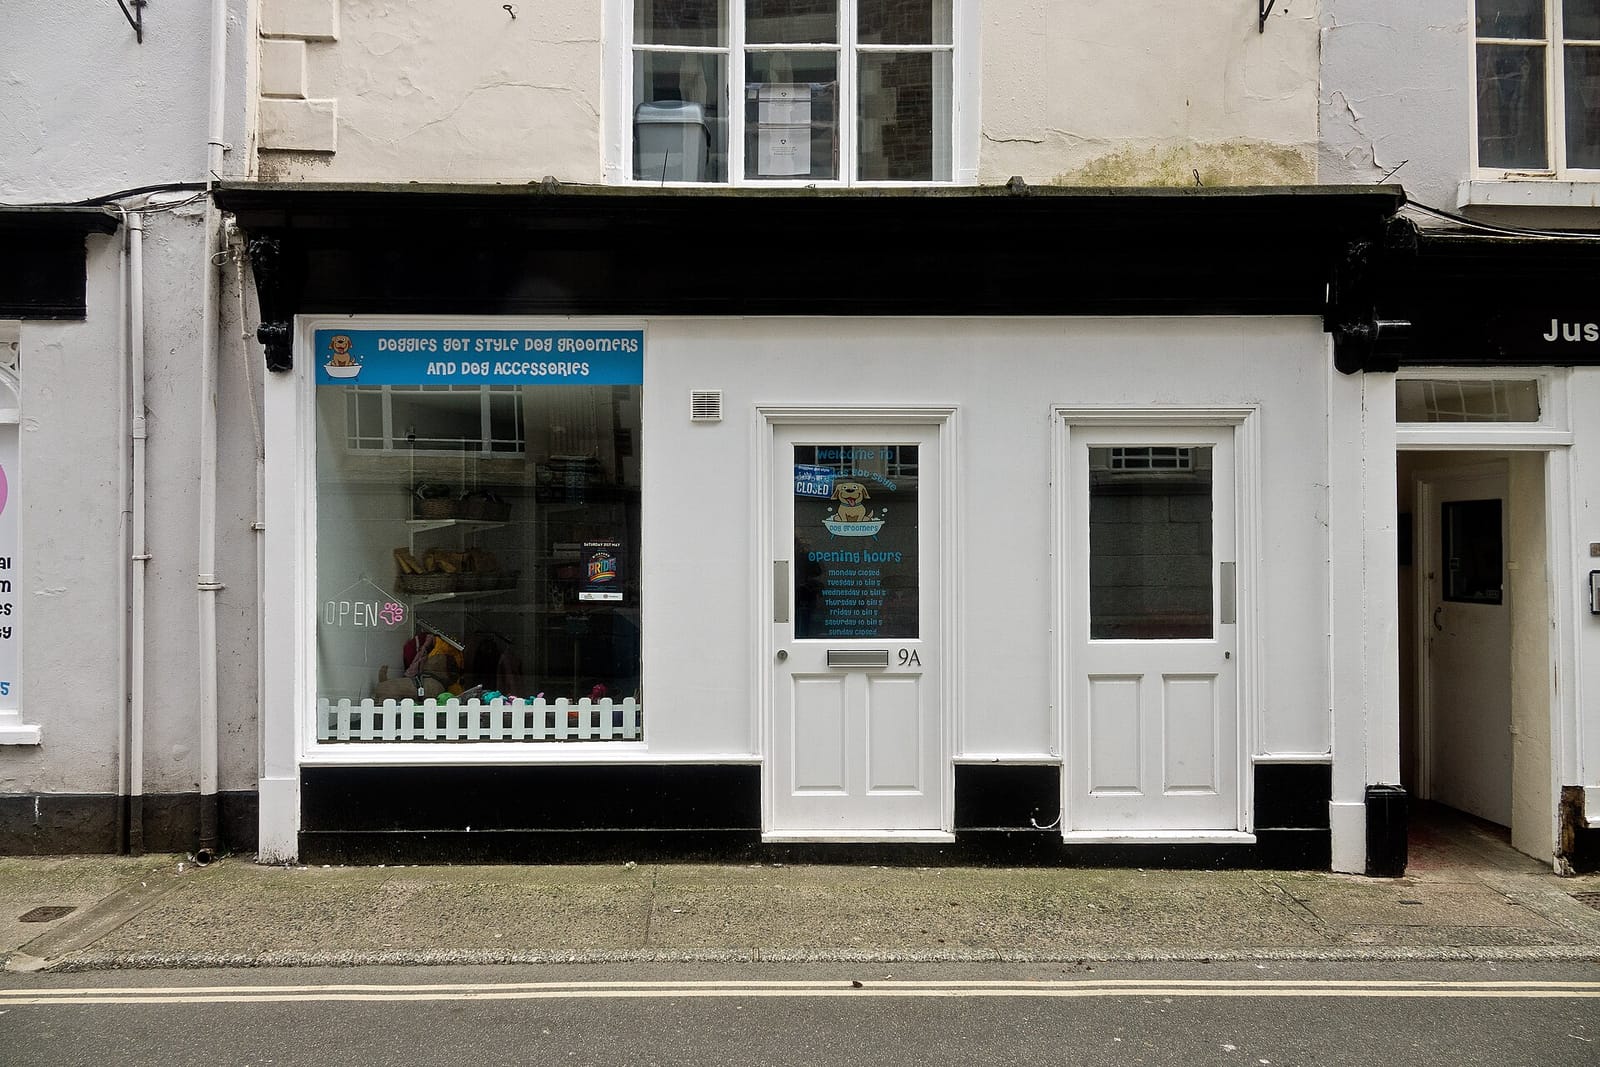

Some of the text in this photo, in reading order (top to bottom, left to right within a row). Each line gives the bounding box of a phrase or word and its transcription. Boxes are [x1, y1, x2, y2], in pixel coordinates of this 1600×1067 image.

[796, 482, 829, 495] CLOSED
[588, 557, 617, 577] PRIDE
[326, 601, 378, 627] OPEN
[898, 648, 922, 667] 9A
